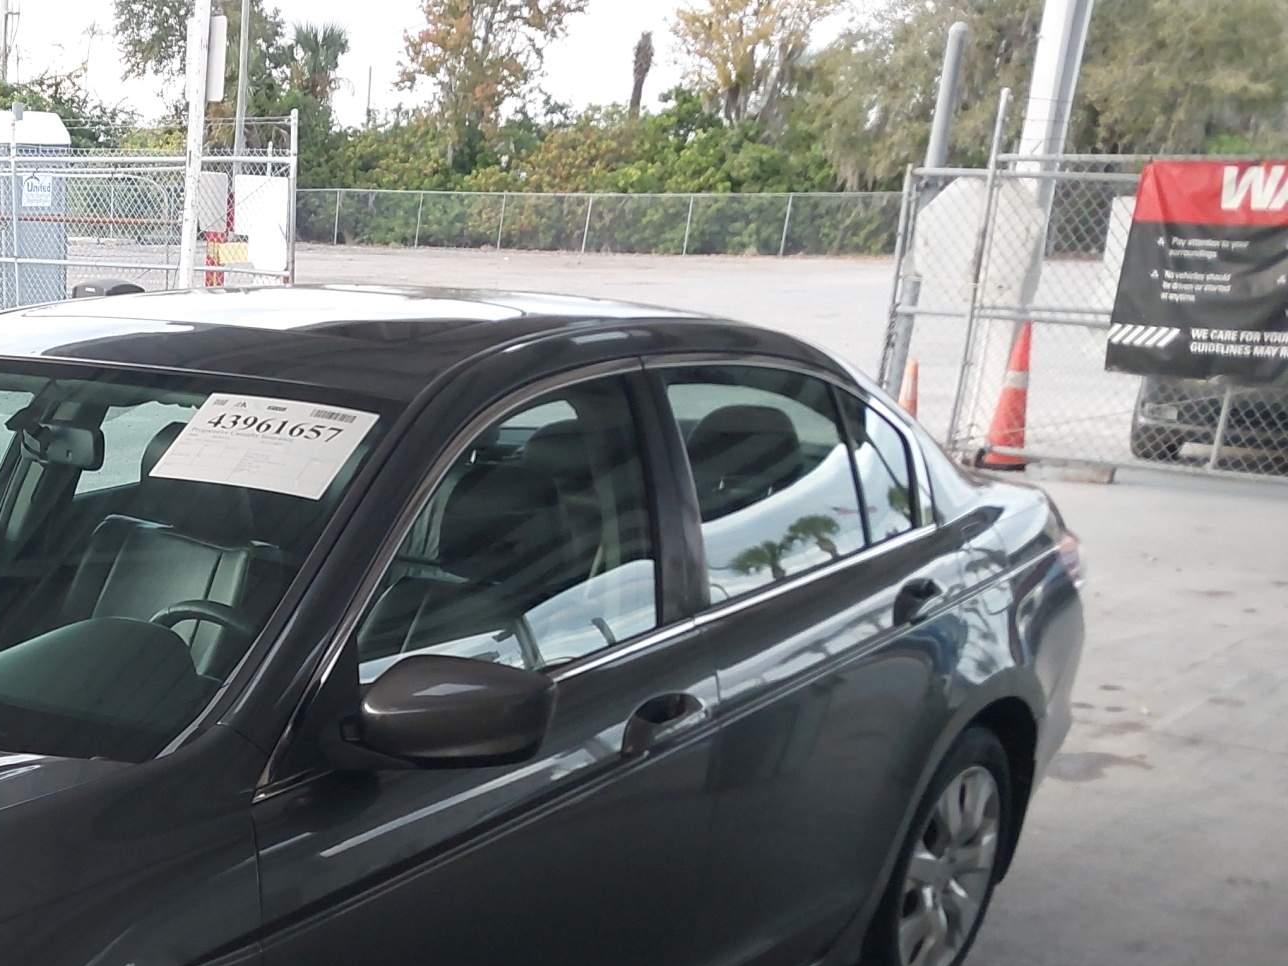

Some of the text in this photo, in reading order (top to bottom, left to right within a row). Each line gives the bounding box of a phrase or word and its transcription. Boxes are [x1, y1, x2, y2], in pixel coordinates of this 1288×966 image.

[26, 182, 51, 193] United
[1191, 328, 1209, 340] WE
[1210, 329, 1239, 342] CARE
[1239, 330, 1262, 343] FOR
[1190, 341, 1251, 356] GUIDELINES
[1253, 345, 1279, 358] MAY
[207, 412, 344, 443] 43961657
